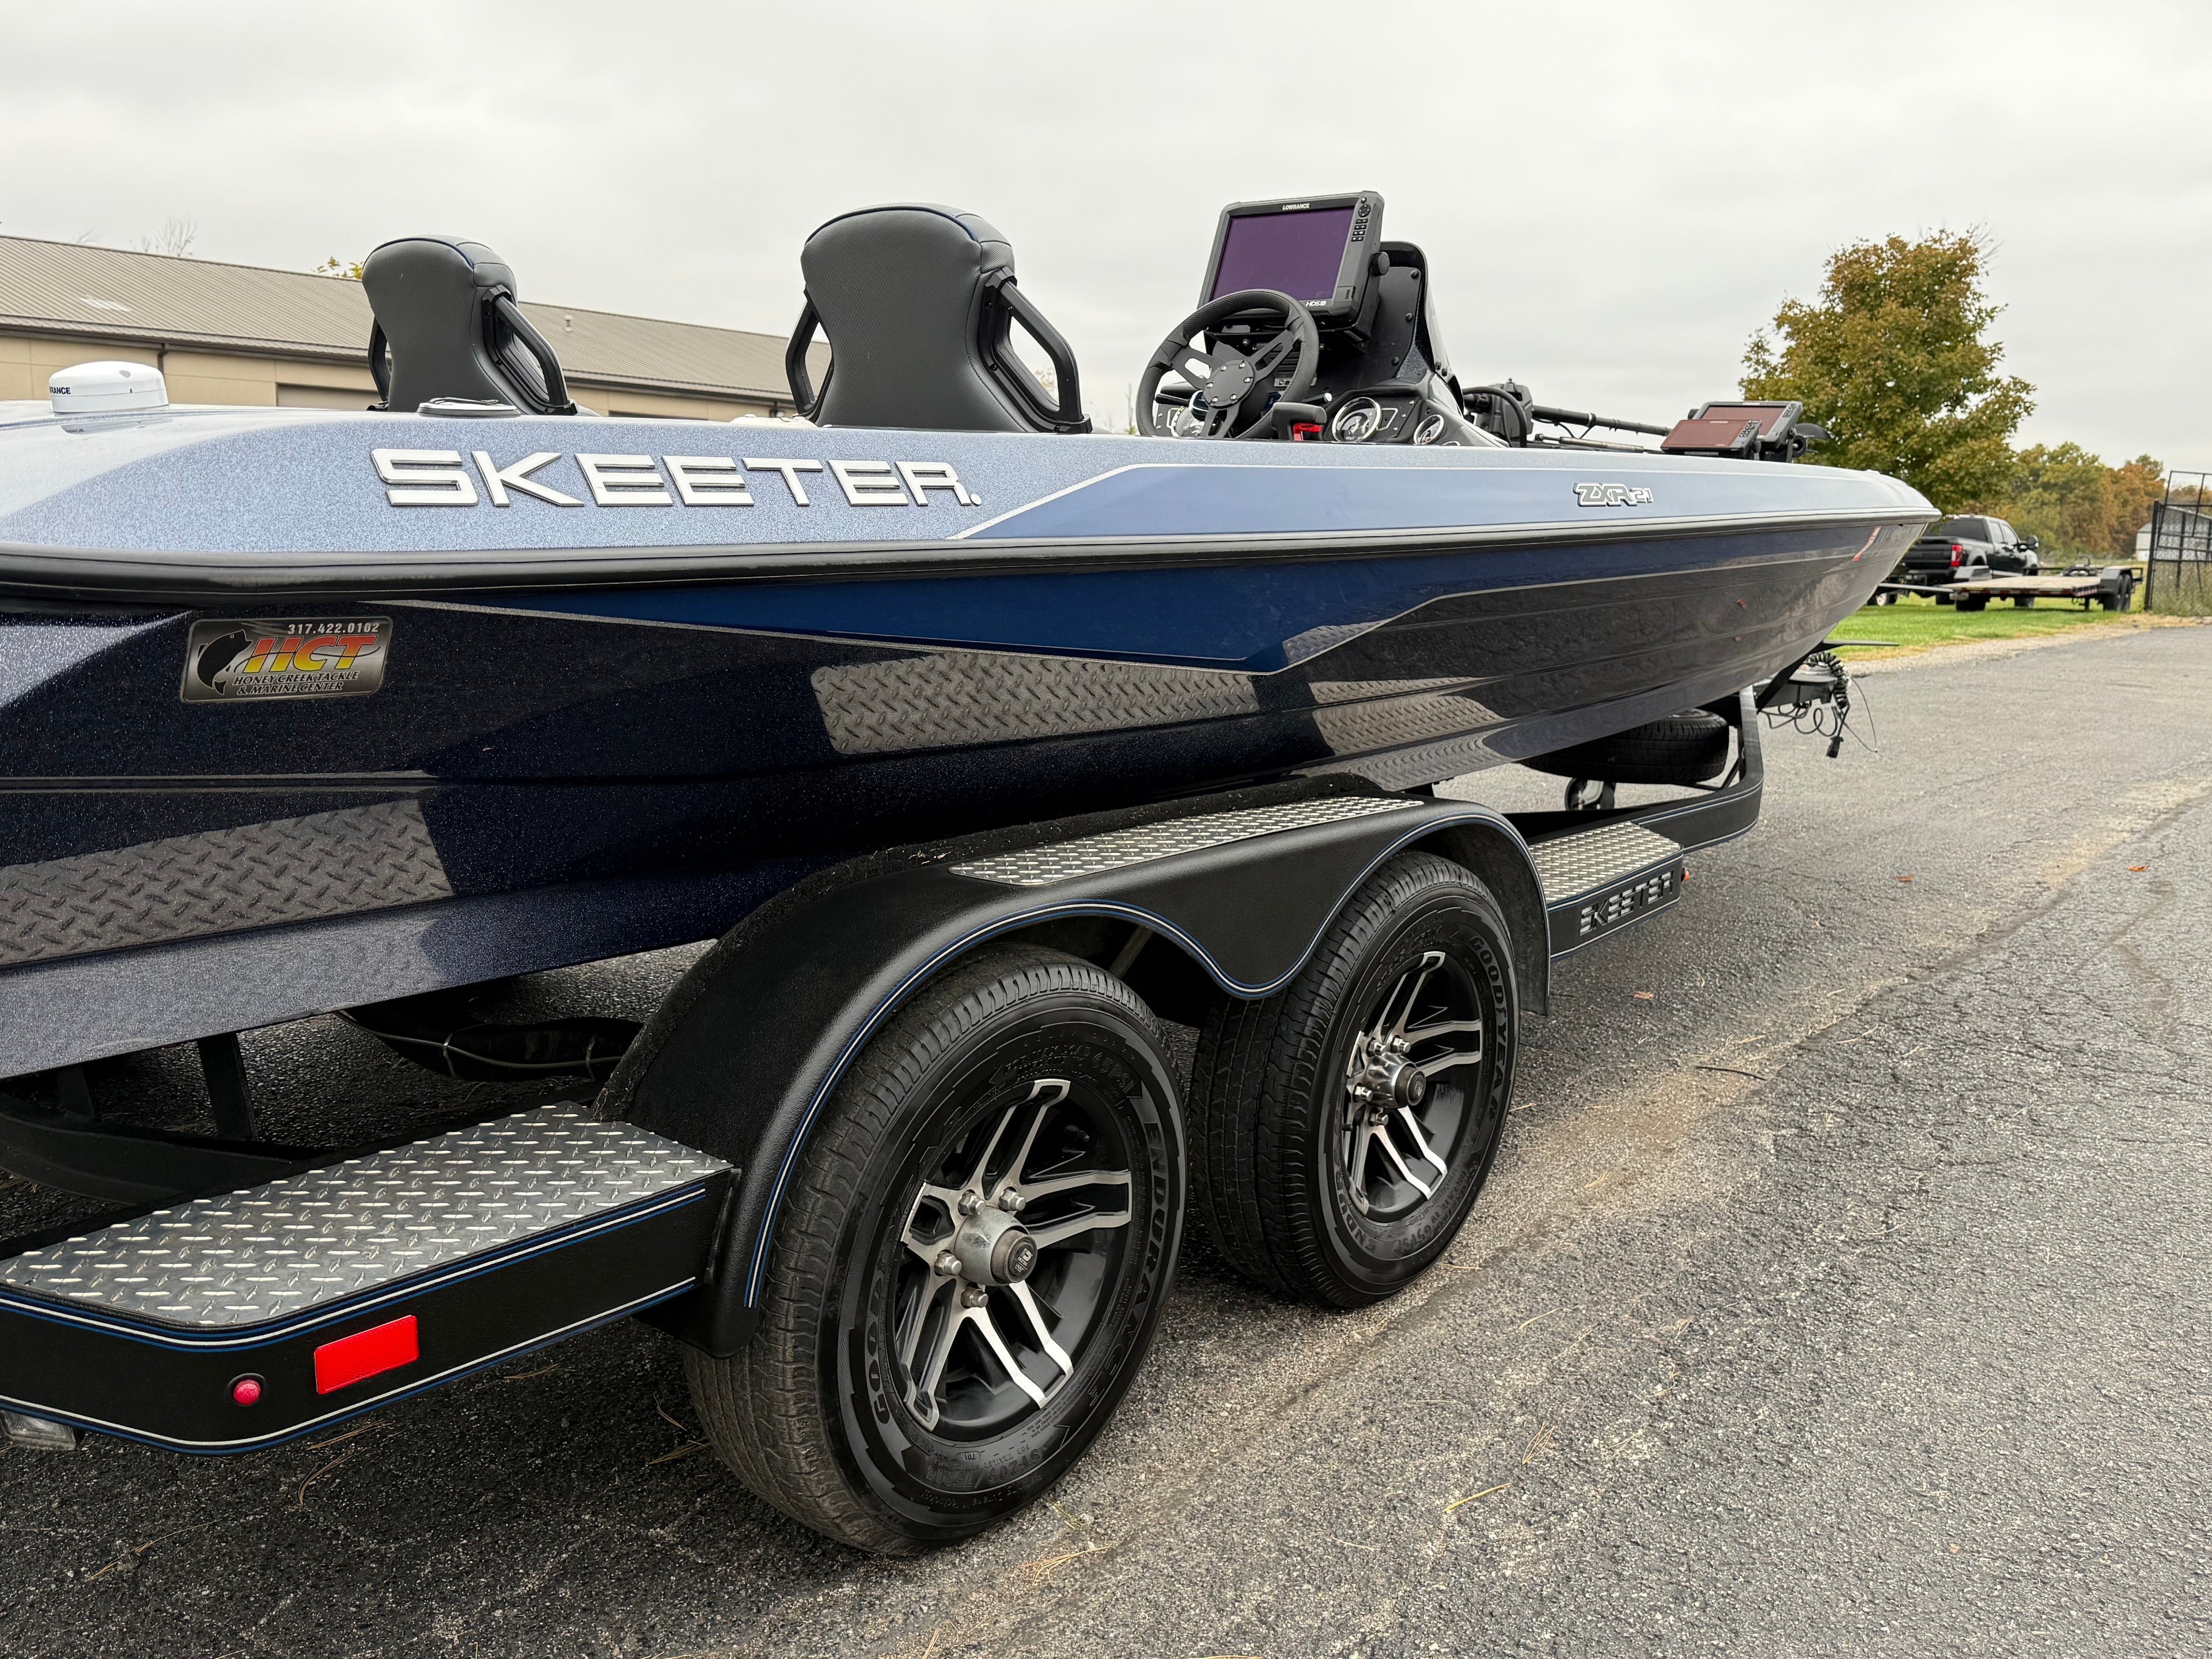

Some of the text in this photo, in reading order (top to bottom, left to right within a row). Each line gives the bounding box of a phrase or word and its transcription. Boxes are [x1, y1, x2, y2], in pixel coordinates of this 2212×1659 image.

[1282, 203, 1310, 211] LOWRANCE
[1573, 482, 1654, 507] ZXR 21
[288, 622, 380, 634] 317.422.0102
[242, 635, 377, 673] HCT
[232, 671, 359, 686] HONEY CREEK TACKLE
[237, 681, 344, 695] & MARINE CENTER
[1580, 870, 1674, 935] SKEETER
[1088, 1122, 1166, 1407] ENDURANCE
